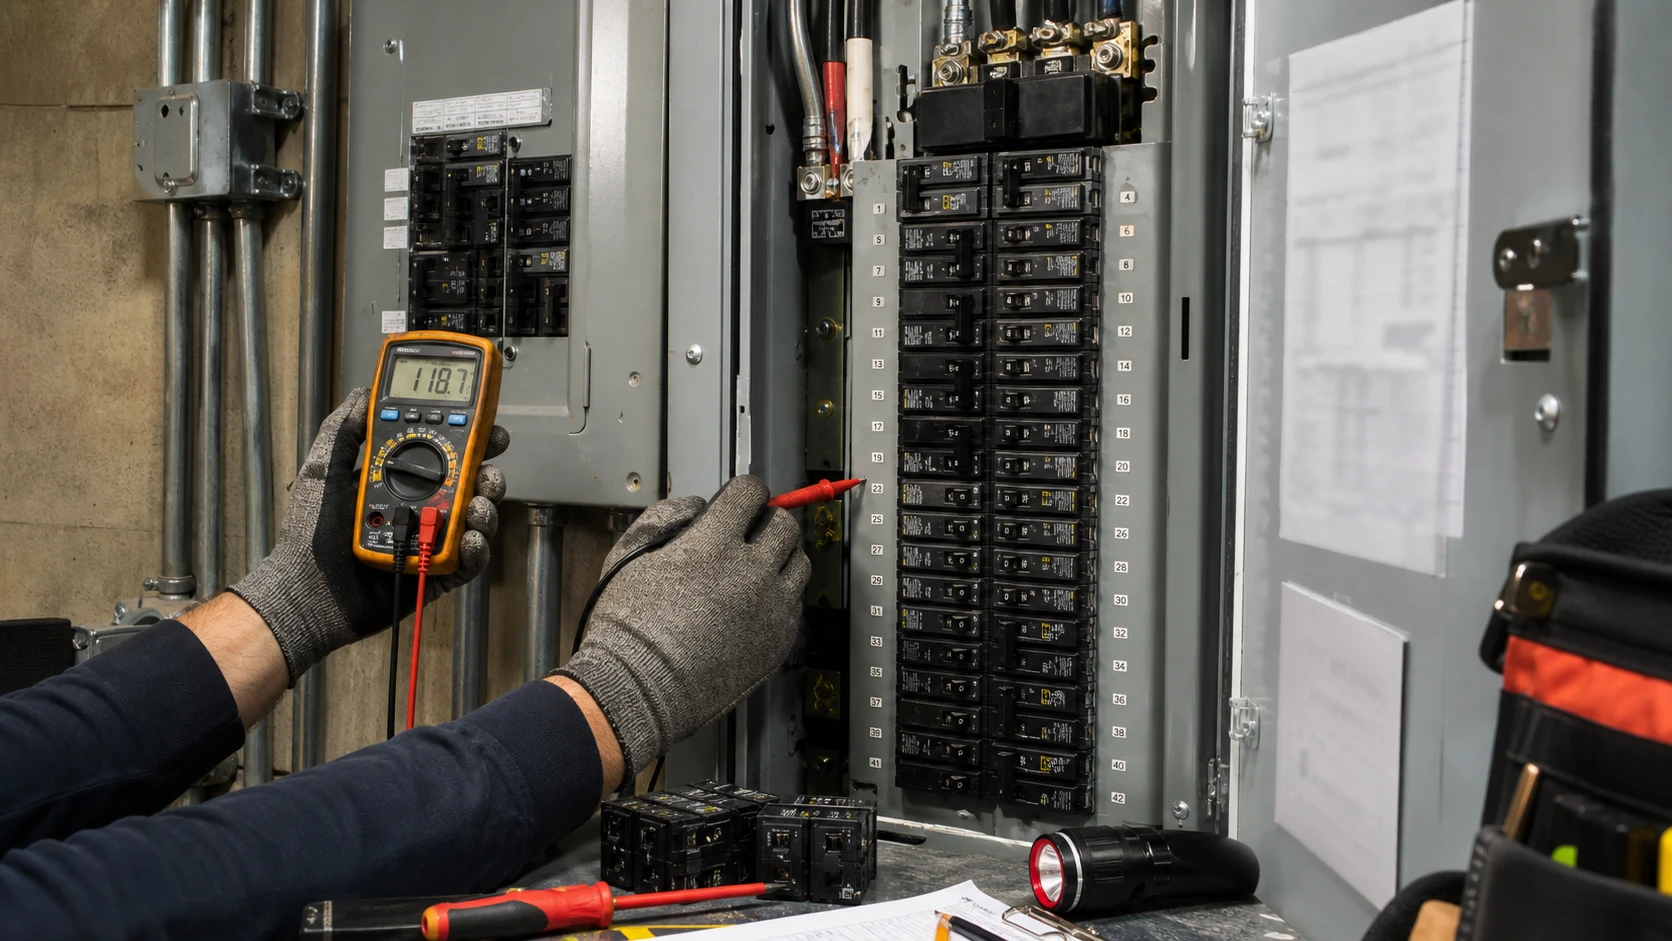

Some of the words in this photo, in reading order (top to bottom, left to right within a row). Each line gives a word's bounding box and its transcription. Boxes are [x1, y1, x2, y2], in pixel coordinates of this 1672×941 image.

[876, 205, 881, 213] 1
[1123, 226, 1131, 236] 6
[876, 235, 882, 244] 5
[1122, 260, 1130, 269] 8
[875, 267, 882, 275] 7
[875, 298, 882, 306] 9
[1121, 294, 1132, 303] 10
[874, 329, 882, 337] 11
[1120, 327, 1131, 336] 12
[874, 360, 883, 368] 13
[1120, 362, 1130, 370] 14
[413, 366, 468, 394] 118.7
[874, 391, 883, 400] 15
[1119, 395, 1130, 404] 16
[874, 422, 883, 430] 17
[1118, 429, 1129, 438] 18
[873, 453, 882, 462] 19
[1117, 462, 1129, 471] 20
[872, 484, 882, 493] 22
[1116, 496, 1128, 505] 22
[872, 515, 882, 523] 25
[1116, 529, 1128, 538] 26
[872, 546, 882, 554] 27
[1115, 562, 1127, 572] 28
[872, 576, 882, 585] 29
[1115, 595, 1127, 605] 30
[872, 607, 881, 615] 31
[1115, 628, 1126, 638] 32
[872, 637, 882, 646] 33
[1114, 661, 1125, 670] 34
[871, 667, 881, 676] 35
[871, 698, 881, 707] 37
[1114, 695, 1125, 704] 36
[870, 728, 881, 737] 39
[1113, 728, 1125, 737] 38
[870, 759, 880, 767] 41
[1113, 761, 1124, 770] 40
[1112, 793, 1124, 803] 42
